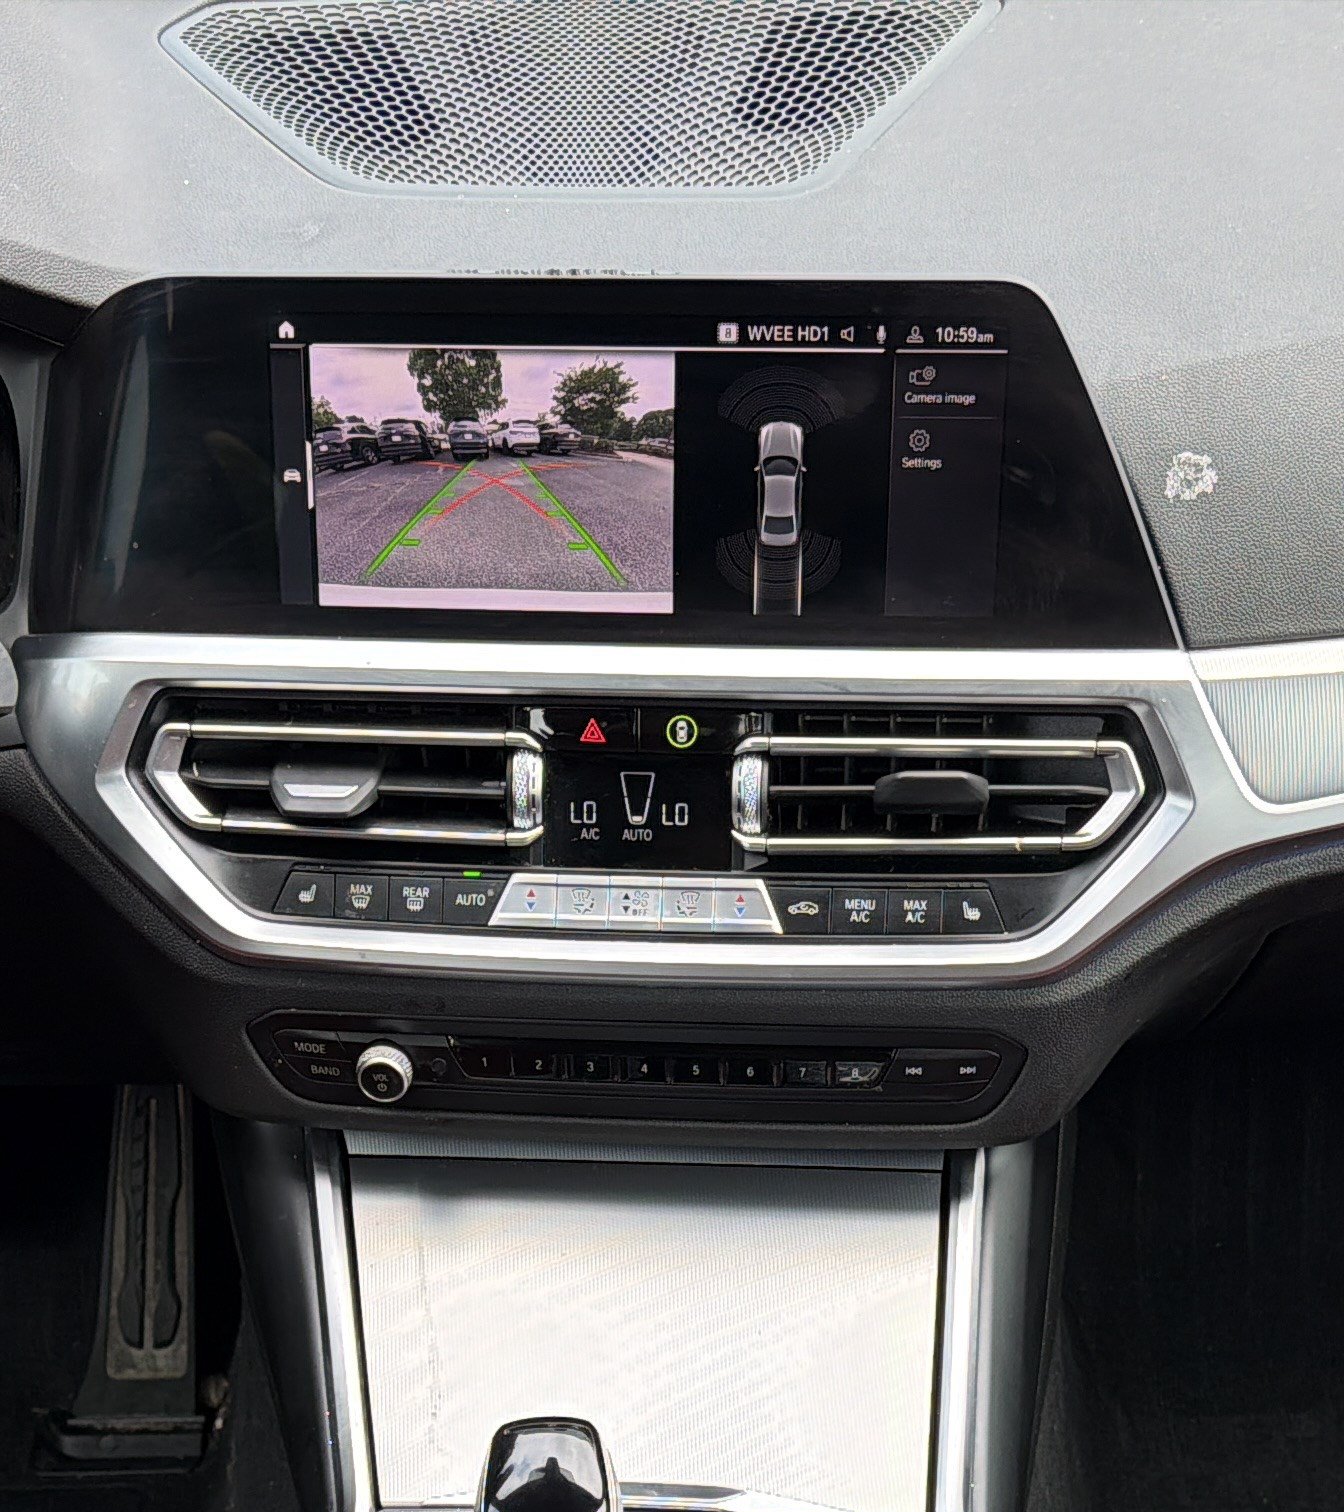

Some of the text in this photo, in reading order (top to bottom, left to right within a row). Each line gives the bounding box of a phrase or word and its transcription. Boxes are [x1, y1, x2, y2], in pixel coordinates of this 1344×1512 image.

[747, 325, 793, 342] WVEE
[797, 326, 829, 342] HD1
[904, 391, 976, 406] Camera image
[901, 456, 942, 470] Settings
[569, 800, 597, 824] LO
[661, 802, 689, 826] LO
[579, 828, 601, 841] A/C
[622, 828, 653, 842] AUTO
[349, 884, 373, 896] MAX
[402, 886, 430, 899] REAR
[455, 892, 486, 907] AUTO
[844, 898, 876, 911] MENU
[903, 899, 928, 912] MAX
[850, 911, 870, 924] A/C
[904, 911, 926, 924] A/C
[294, 1041, 327, 1055] MODE
[310, 1064, 341, 1077] BAND
[481, 1056, 488, 1068] 1
[535, 1059, 543, 1071] 2
[586, 1061, 595, 1072] 3
[640, 1062, 648, 1074] 4
[692, 1064, 700, 1076] 5
[746, 1066, 754, 1078] 6
[799, 1067, 807, 1079] 7
[372, 1073, 388, 1082] VOL
